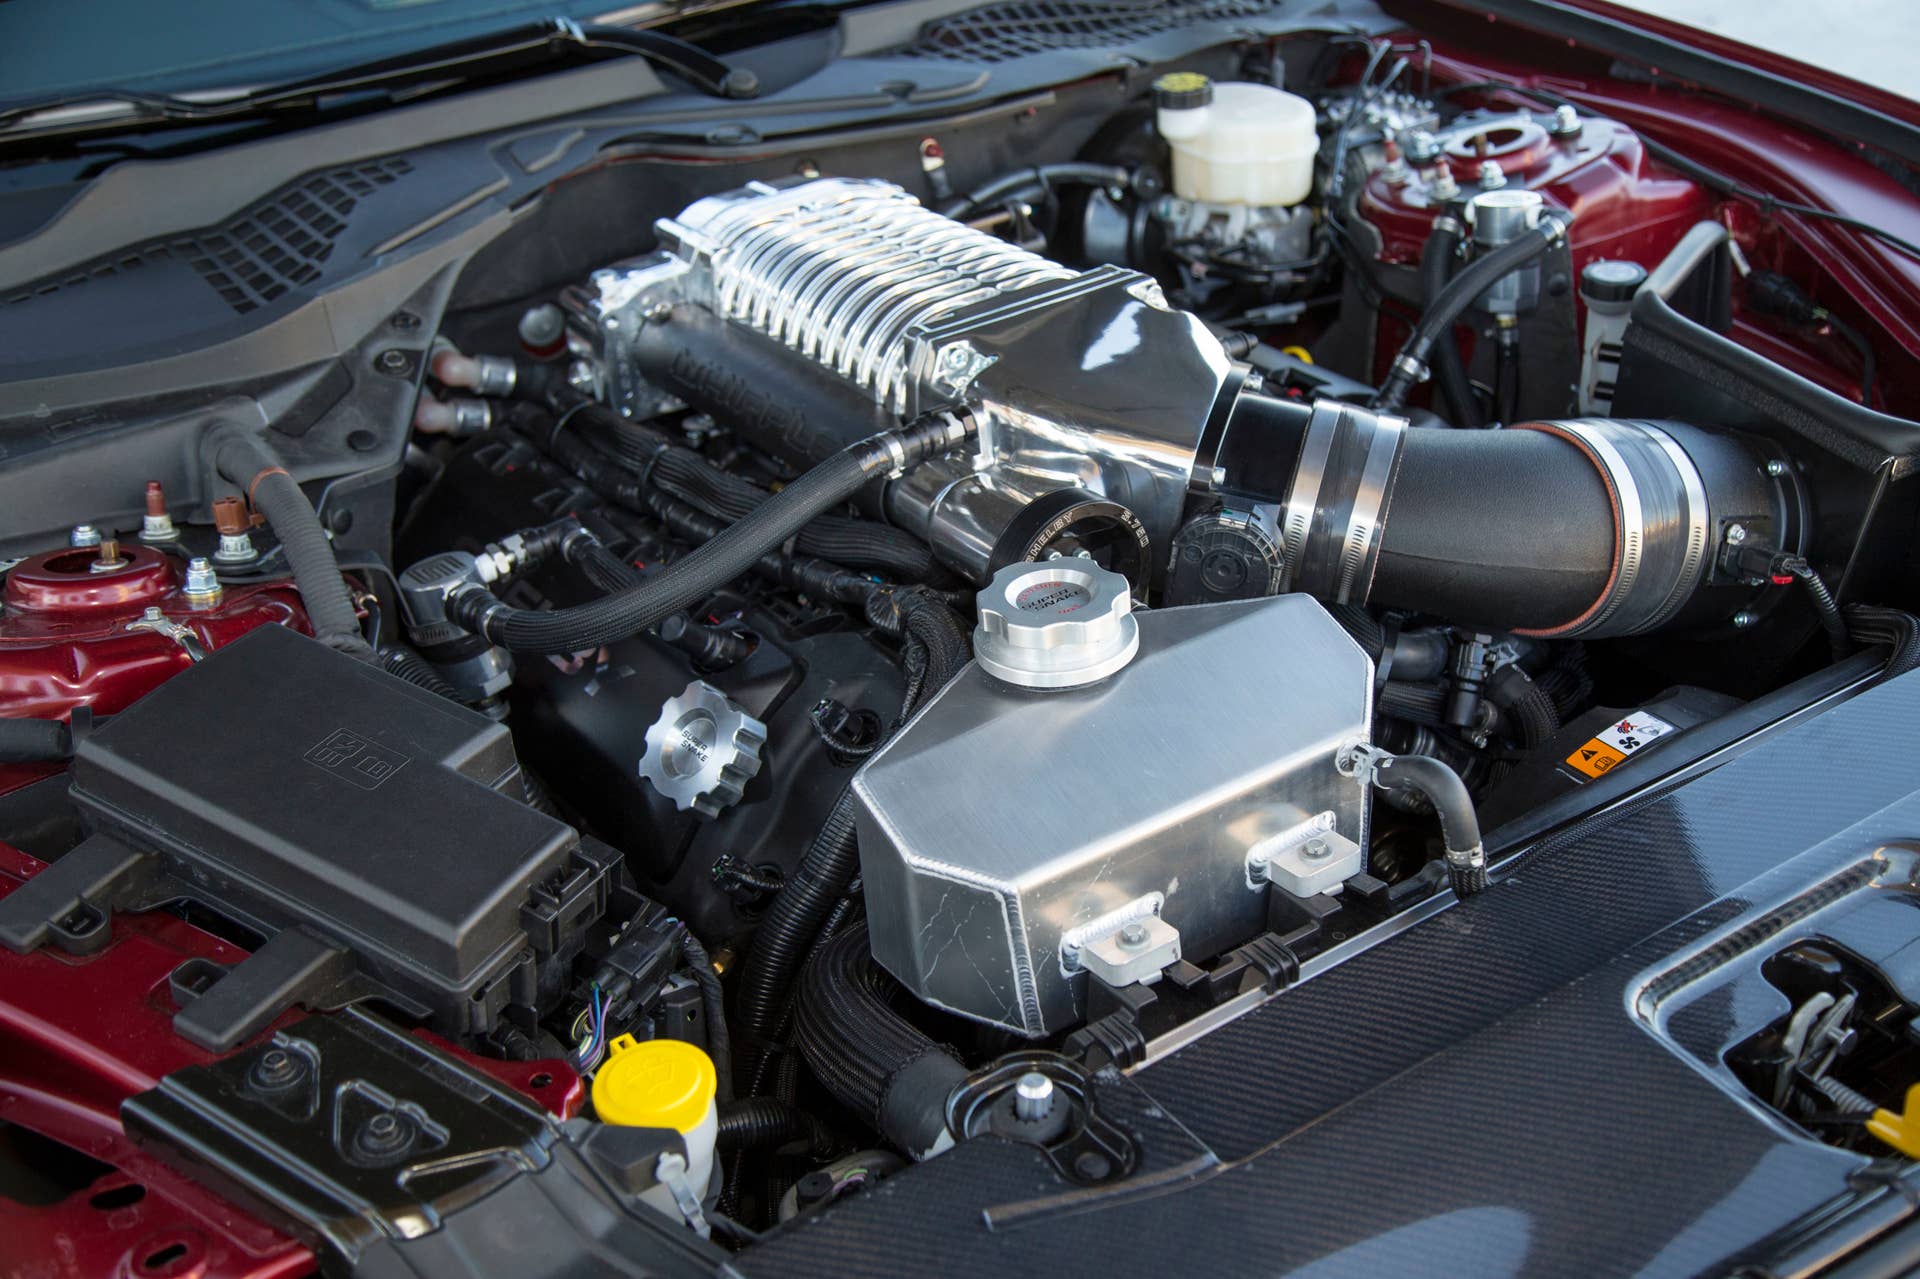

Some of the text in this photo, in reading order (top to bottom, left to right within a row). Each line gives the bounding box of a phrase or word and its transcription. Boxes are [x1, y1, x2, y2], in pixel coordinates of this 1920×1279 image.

[1025, 511, 1073, 563] SHELBY
[1021, 588, 1069, 610] SUPER
[1034, 589, 1085, 611] SNAKE
[681, 740, 709, 762] SNAKE
[682, 730, 708, 751] SUPER
